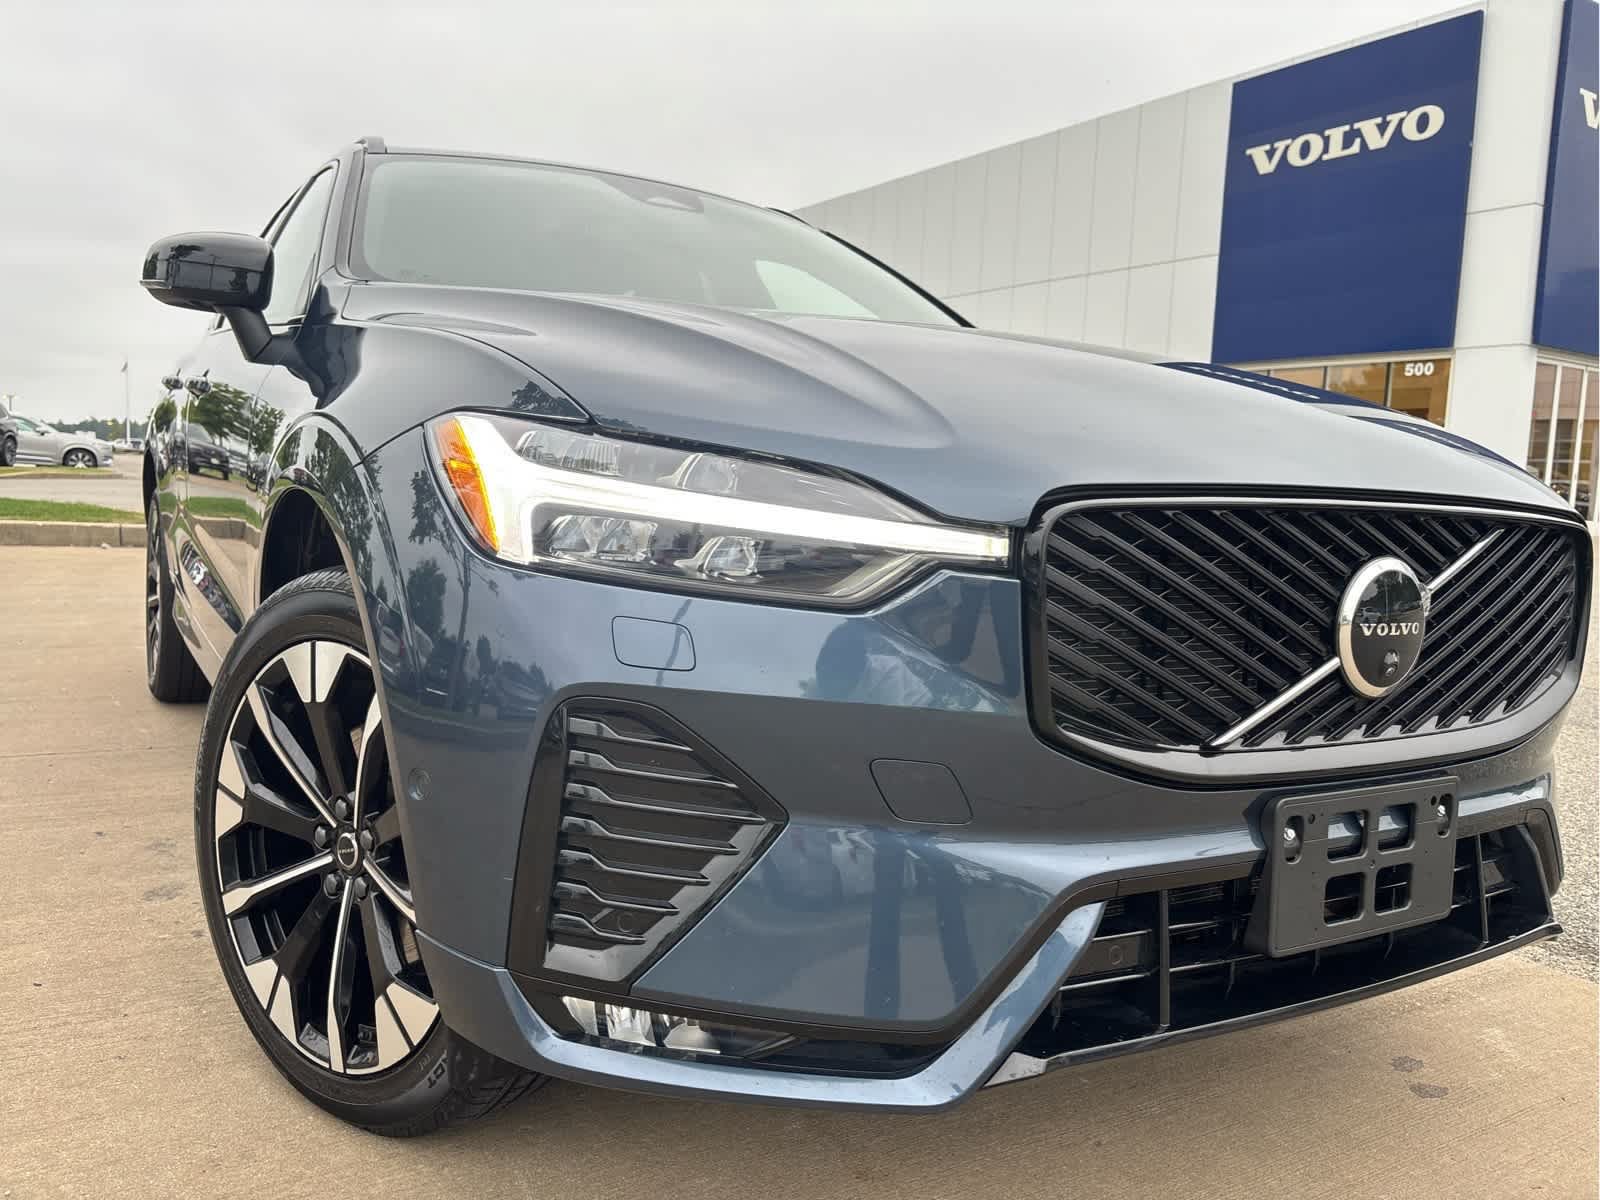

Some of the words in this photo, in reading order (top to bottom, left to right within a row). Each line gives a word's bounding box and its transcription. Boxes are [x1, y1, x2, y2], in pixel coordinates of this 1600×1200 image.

[1246, 105, 1445, 175] VOLVO
[1404, 362, 1434, 377] 500
[1360, 622, 1420, 636] VOLVO
